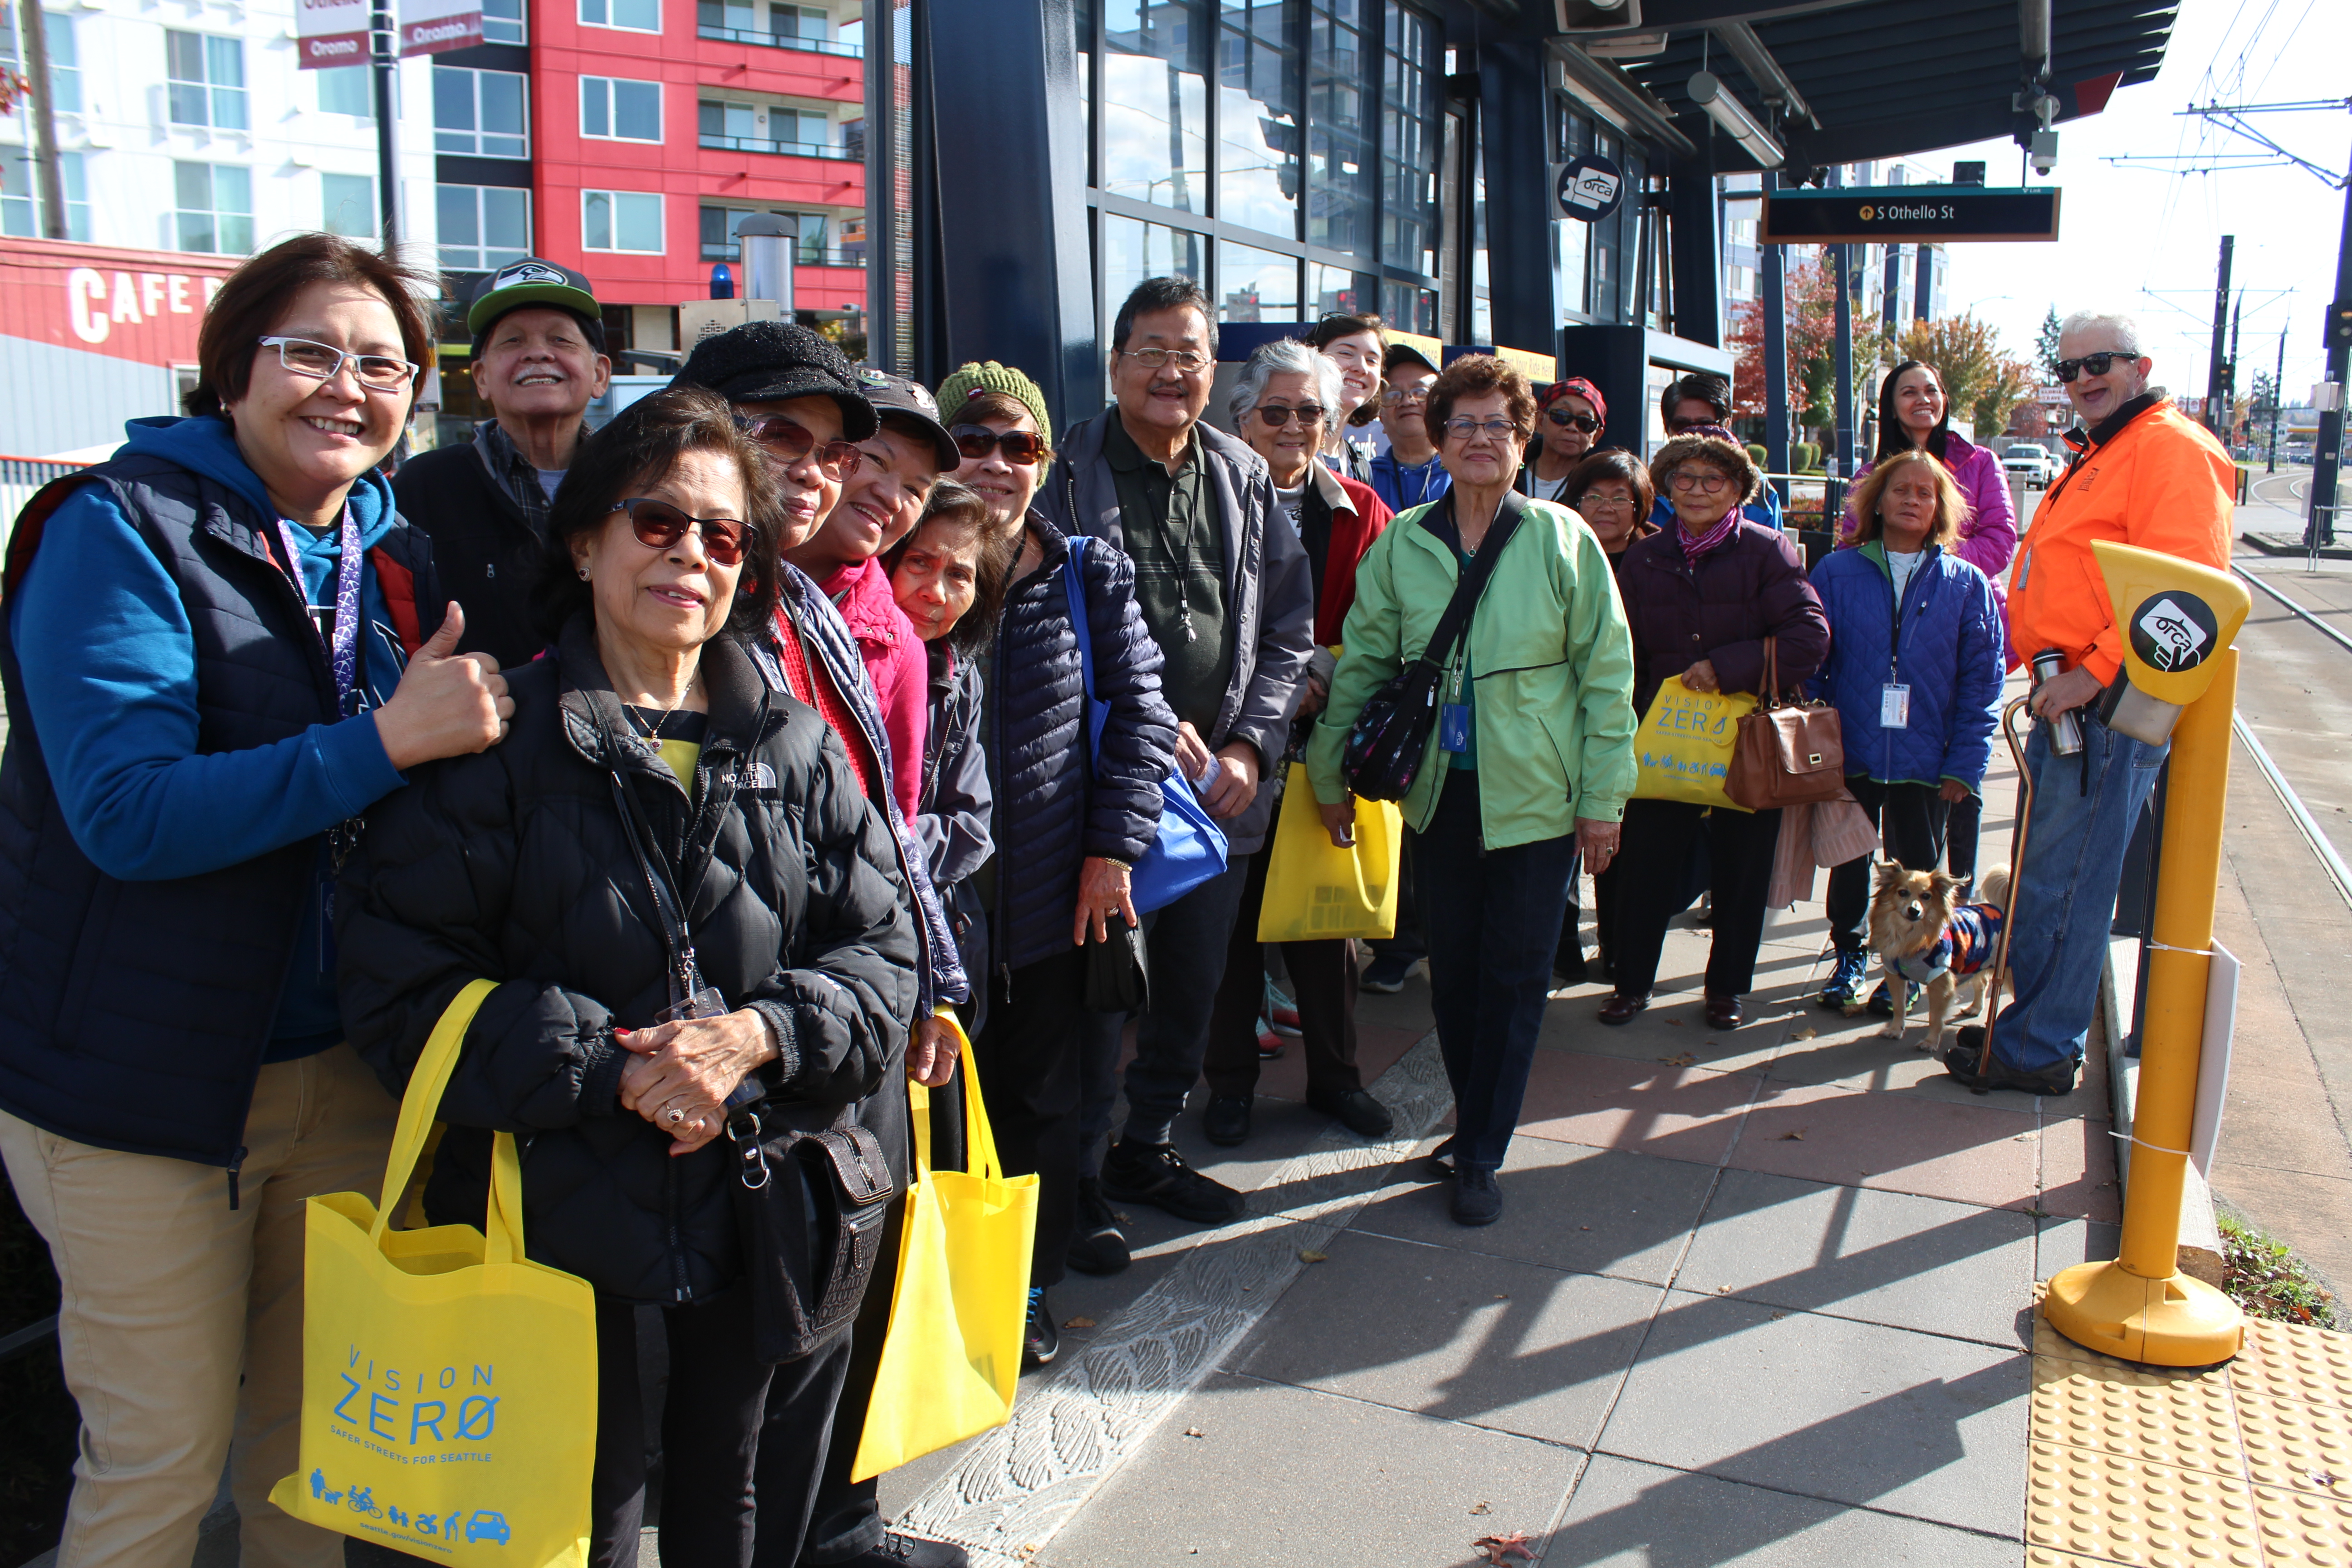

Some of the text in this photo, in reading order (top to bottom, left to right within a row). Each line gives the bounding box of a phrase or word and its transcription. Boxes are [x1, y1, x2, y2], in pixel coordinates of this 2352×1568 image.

[412, 22, 467, 42] Oromo
[310, 39, 359, 57] Oromo
[1583, 179, 1612, 197] orca
[1877, 205, 1954, 220] S Othello St
[69, 267, 193, 344] CAFE
[1515, 355, 1527, 372] Your
[1529, 357, 1540, 376] Ride
[1542, 360, 1553, 377] Here
[2156, 618, 2191, 653] orca
[350, 1343, 493, 1394] VISION
[330, 1425, 492, 1465] SAFER STREETS FOR SEATTLE
[360, 1523, 452, 1553] seattle.gov/visionzero
